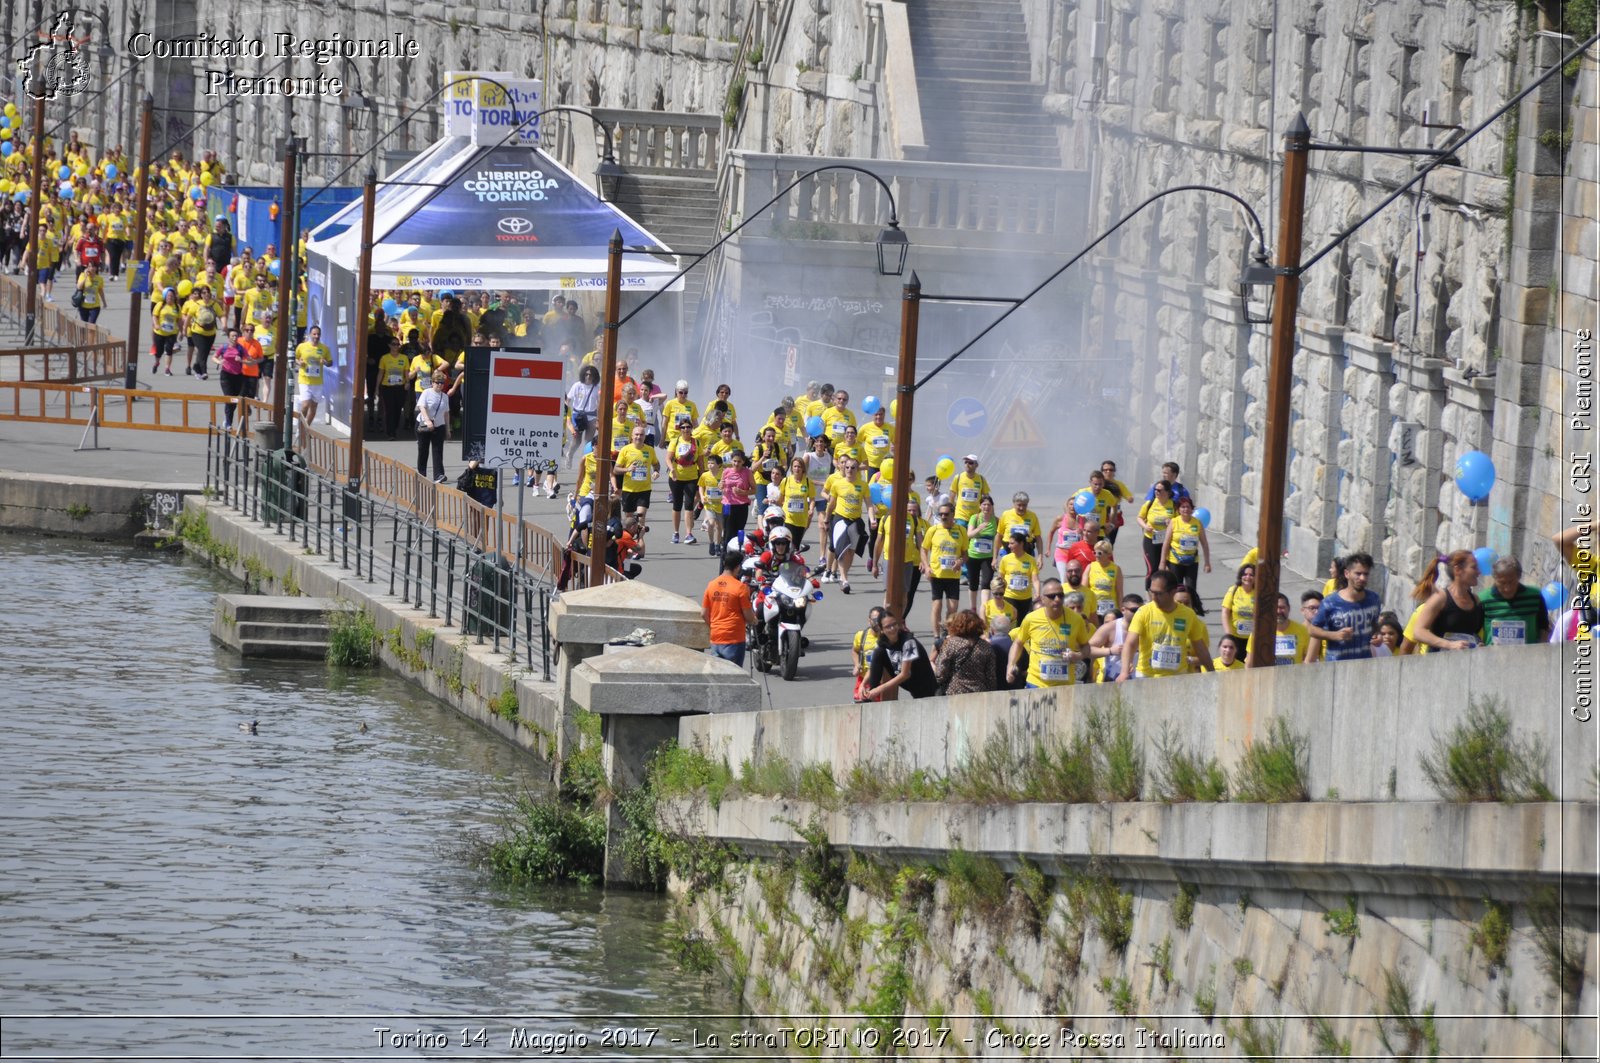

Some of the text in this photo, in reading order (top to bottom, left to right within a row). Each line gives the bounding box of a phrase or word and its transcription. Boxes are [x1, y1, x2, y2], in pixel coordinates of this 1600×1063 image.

[479, 109, 540, 127] TORINO
[477, 170, 543, 181] L'IBRIDO
[463, 178, 559, 192] CONTAGIA
[475, 189, 549, 202] TORINO.
[490, 426, 559, 438] oltre il ponte
[500, 438, 509, 446] di
[513, 438, 538, 447] valle
[504, 448, 543, 458] 150 mt.
